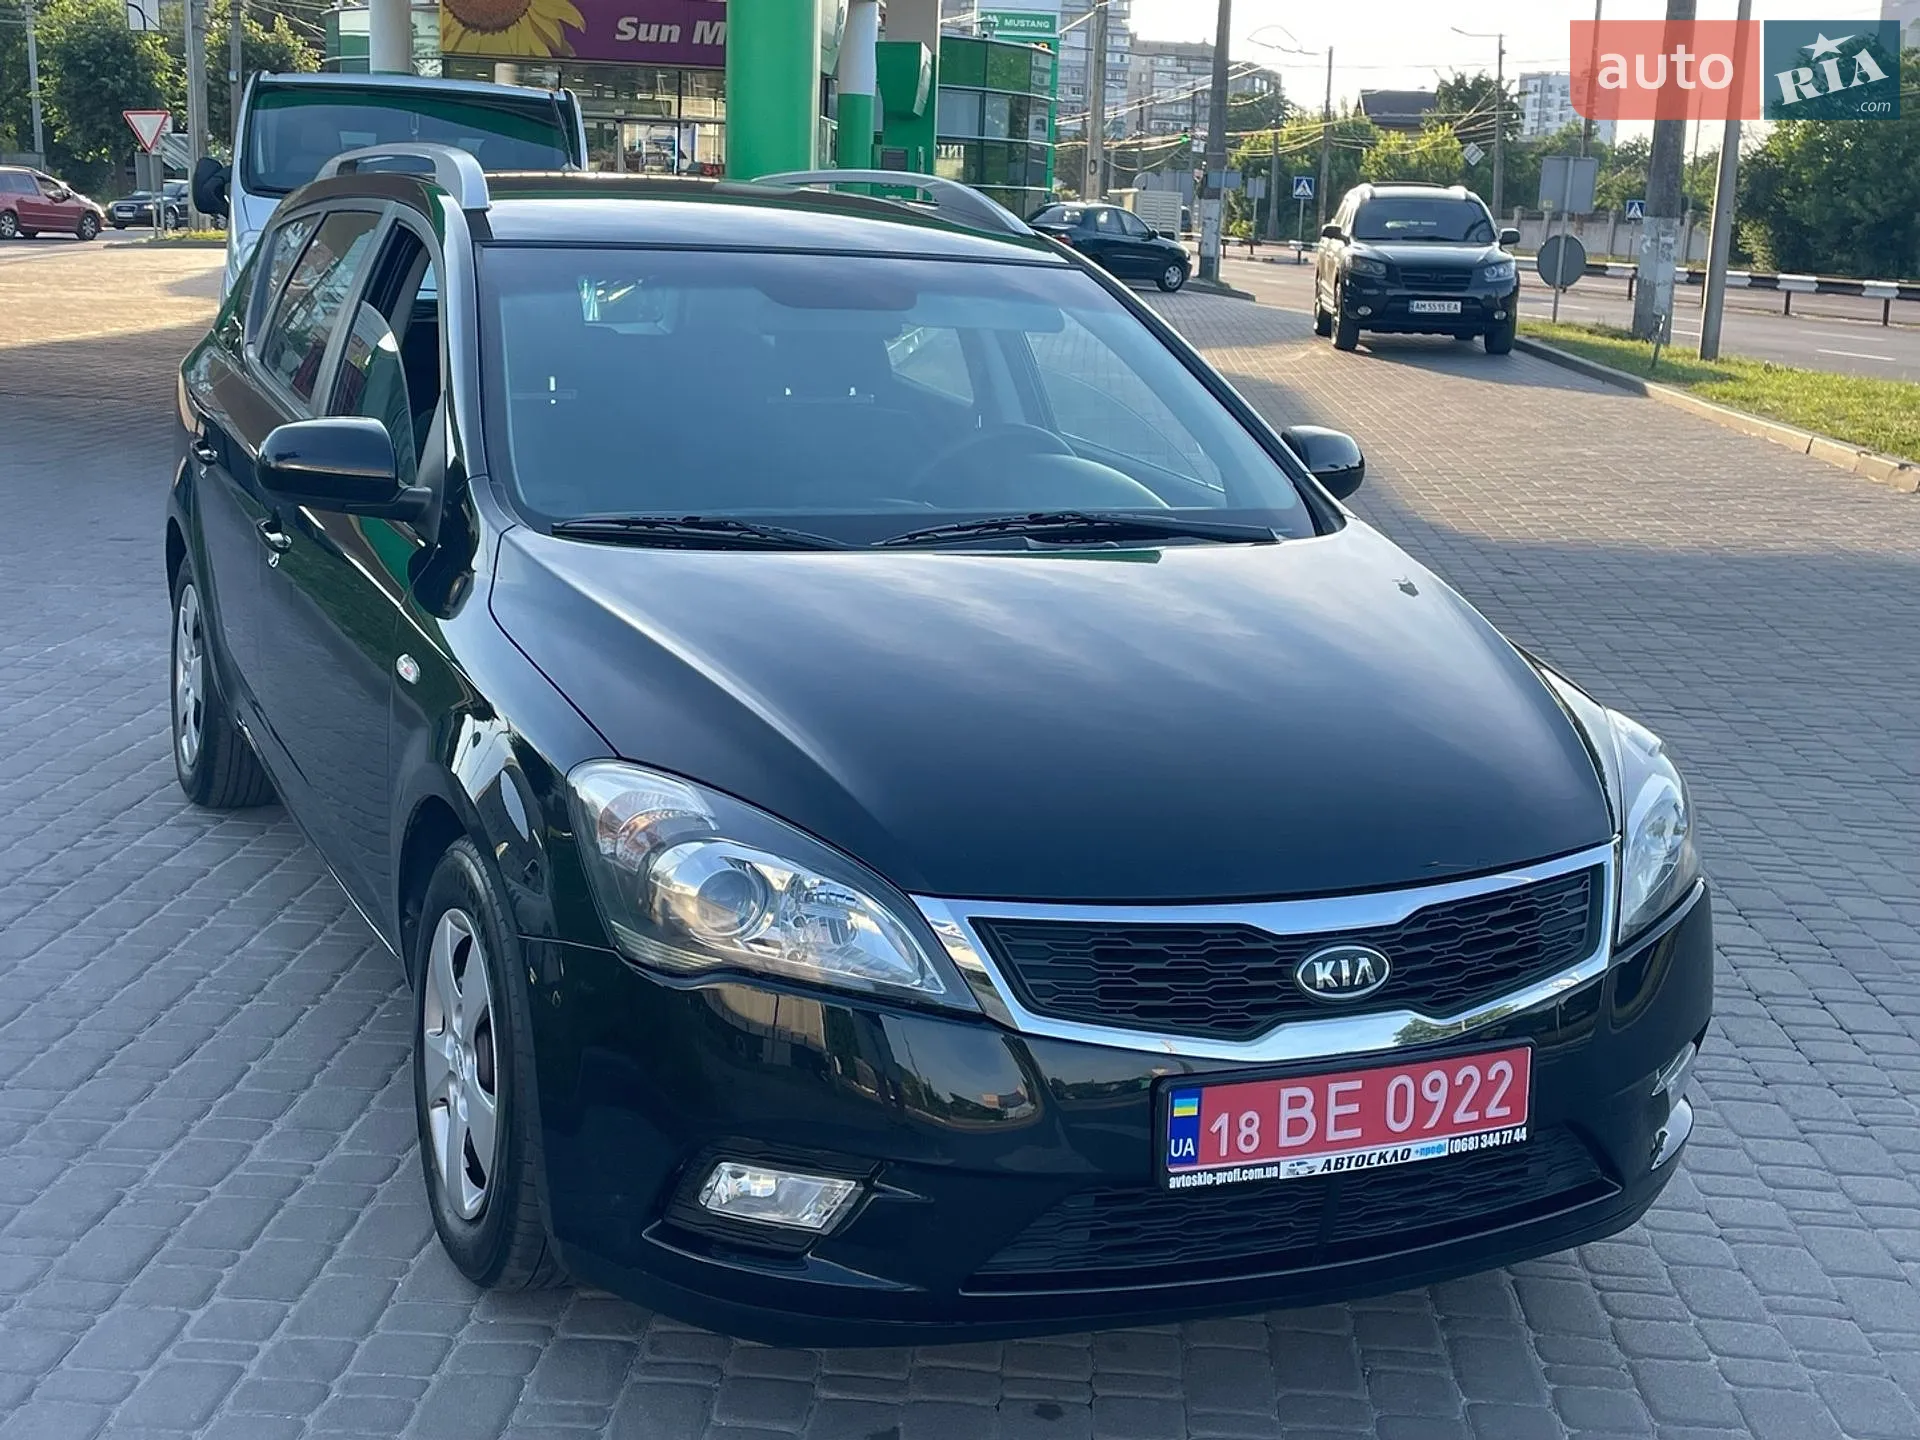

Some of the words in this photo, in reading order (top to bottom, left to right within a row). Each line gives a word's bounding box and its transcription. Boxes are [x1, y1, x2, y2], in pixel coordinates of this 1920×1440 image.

[615, 16, 681, 43] Sun
[1003, 18, 1051, 29] MUSTANG
[1313, 957, 1376, 990] KIA
[1209, 1110, 1261, 1157] 18
[1278, 1079, 1364, 1149] BE
[1385, 1059, 1515, 1134] 0922
[1170, 1137, 1196, 1158] UA
[1320, 1147, 1412, 1173] АВТОСКЛО
[1449, 1136, 1479, 1154] (068)
[1480, 1131, 1500, 1149] 344
